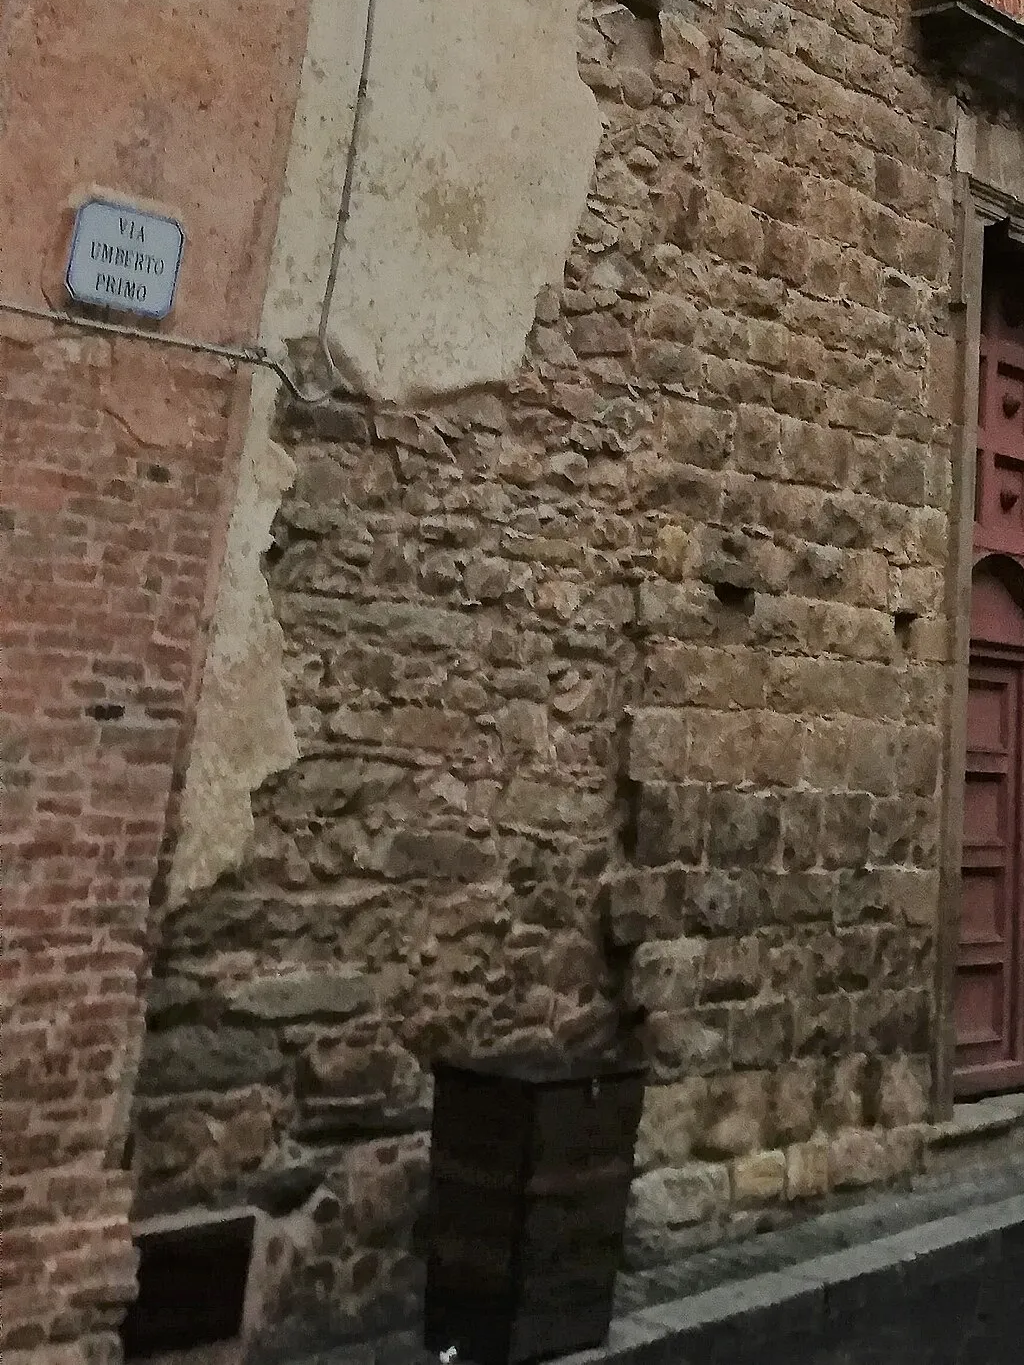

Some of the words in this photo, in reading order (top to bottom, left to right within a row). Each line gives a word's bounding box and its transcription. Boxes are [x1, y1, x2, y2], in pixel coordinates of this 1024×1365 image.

[119, 217, 145, 243] VIA
[90, 241, 164, 275] UMBERTO
[95, 273, 147, 302] PRIMO
